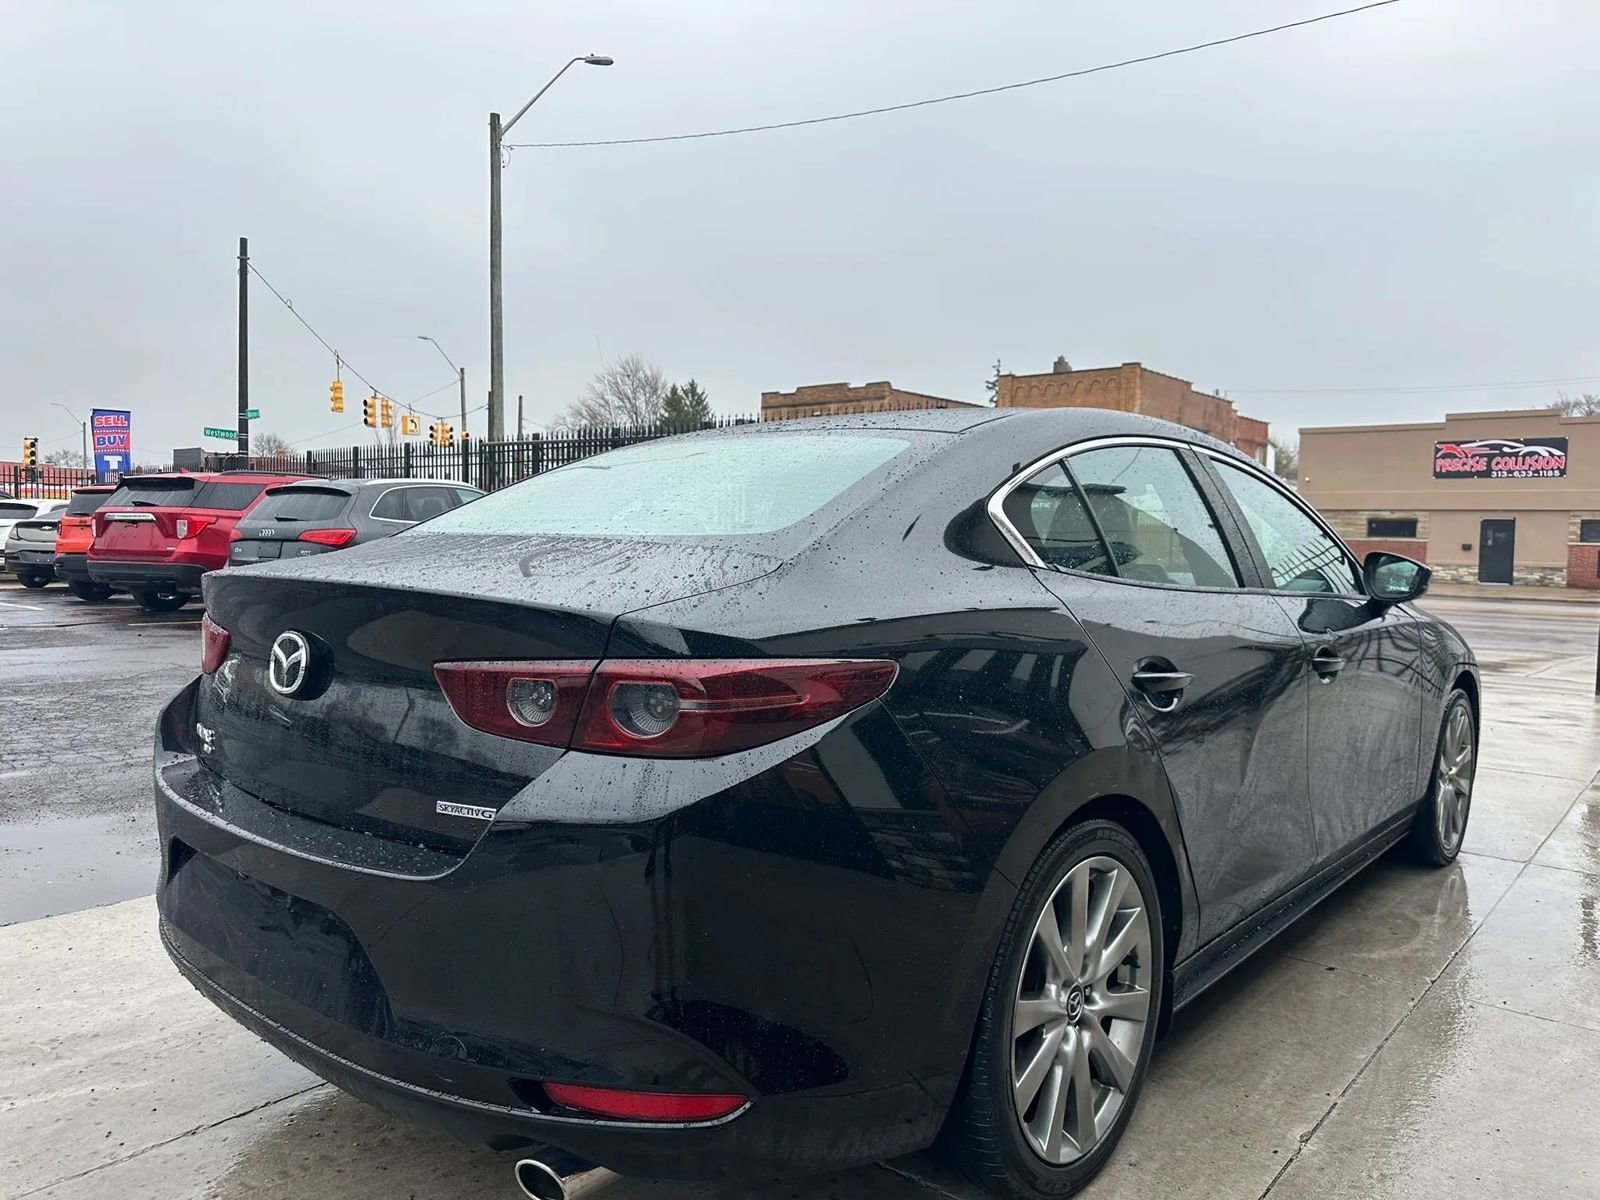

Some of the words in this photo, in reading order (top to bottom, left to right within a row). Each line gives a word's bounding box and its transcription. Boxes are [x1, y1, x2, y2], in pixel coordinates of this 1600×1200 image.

[95, 415, 128, 427] SELL
[205, 429, 238, 439] Westwood
[95, 435, 126, 447] BUY
[1435, 457, 1488, 472] PRECISE
[1490, 454, 1566, 471] COLLISION
